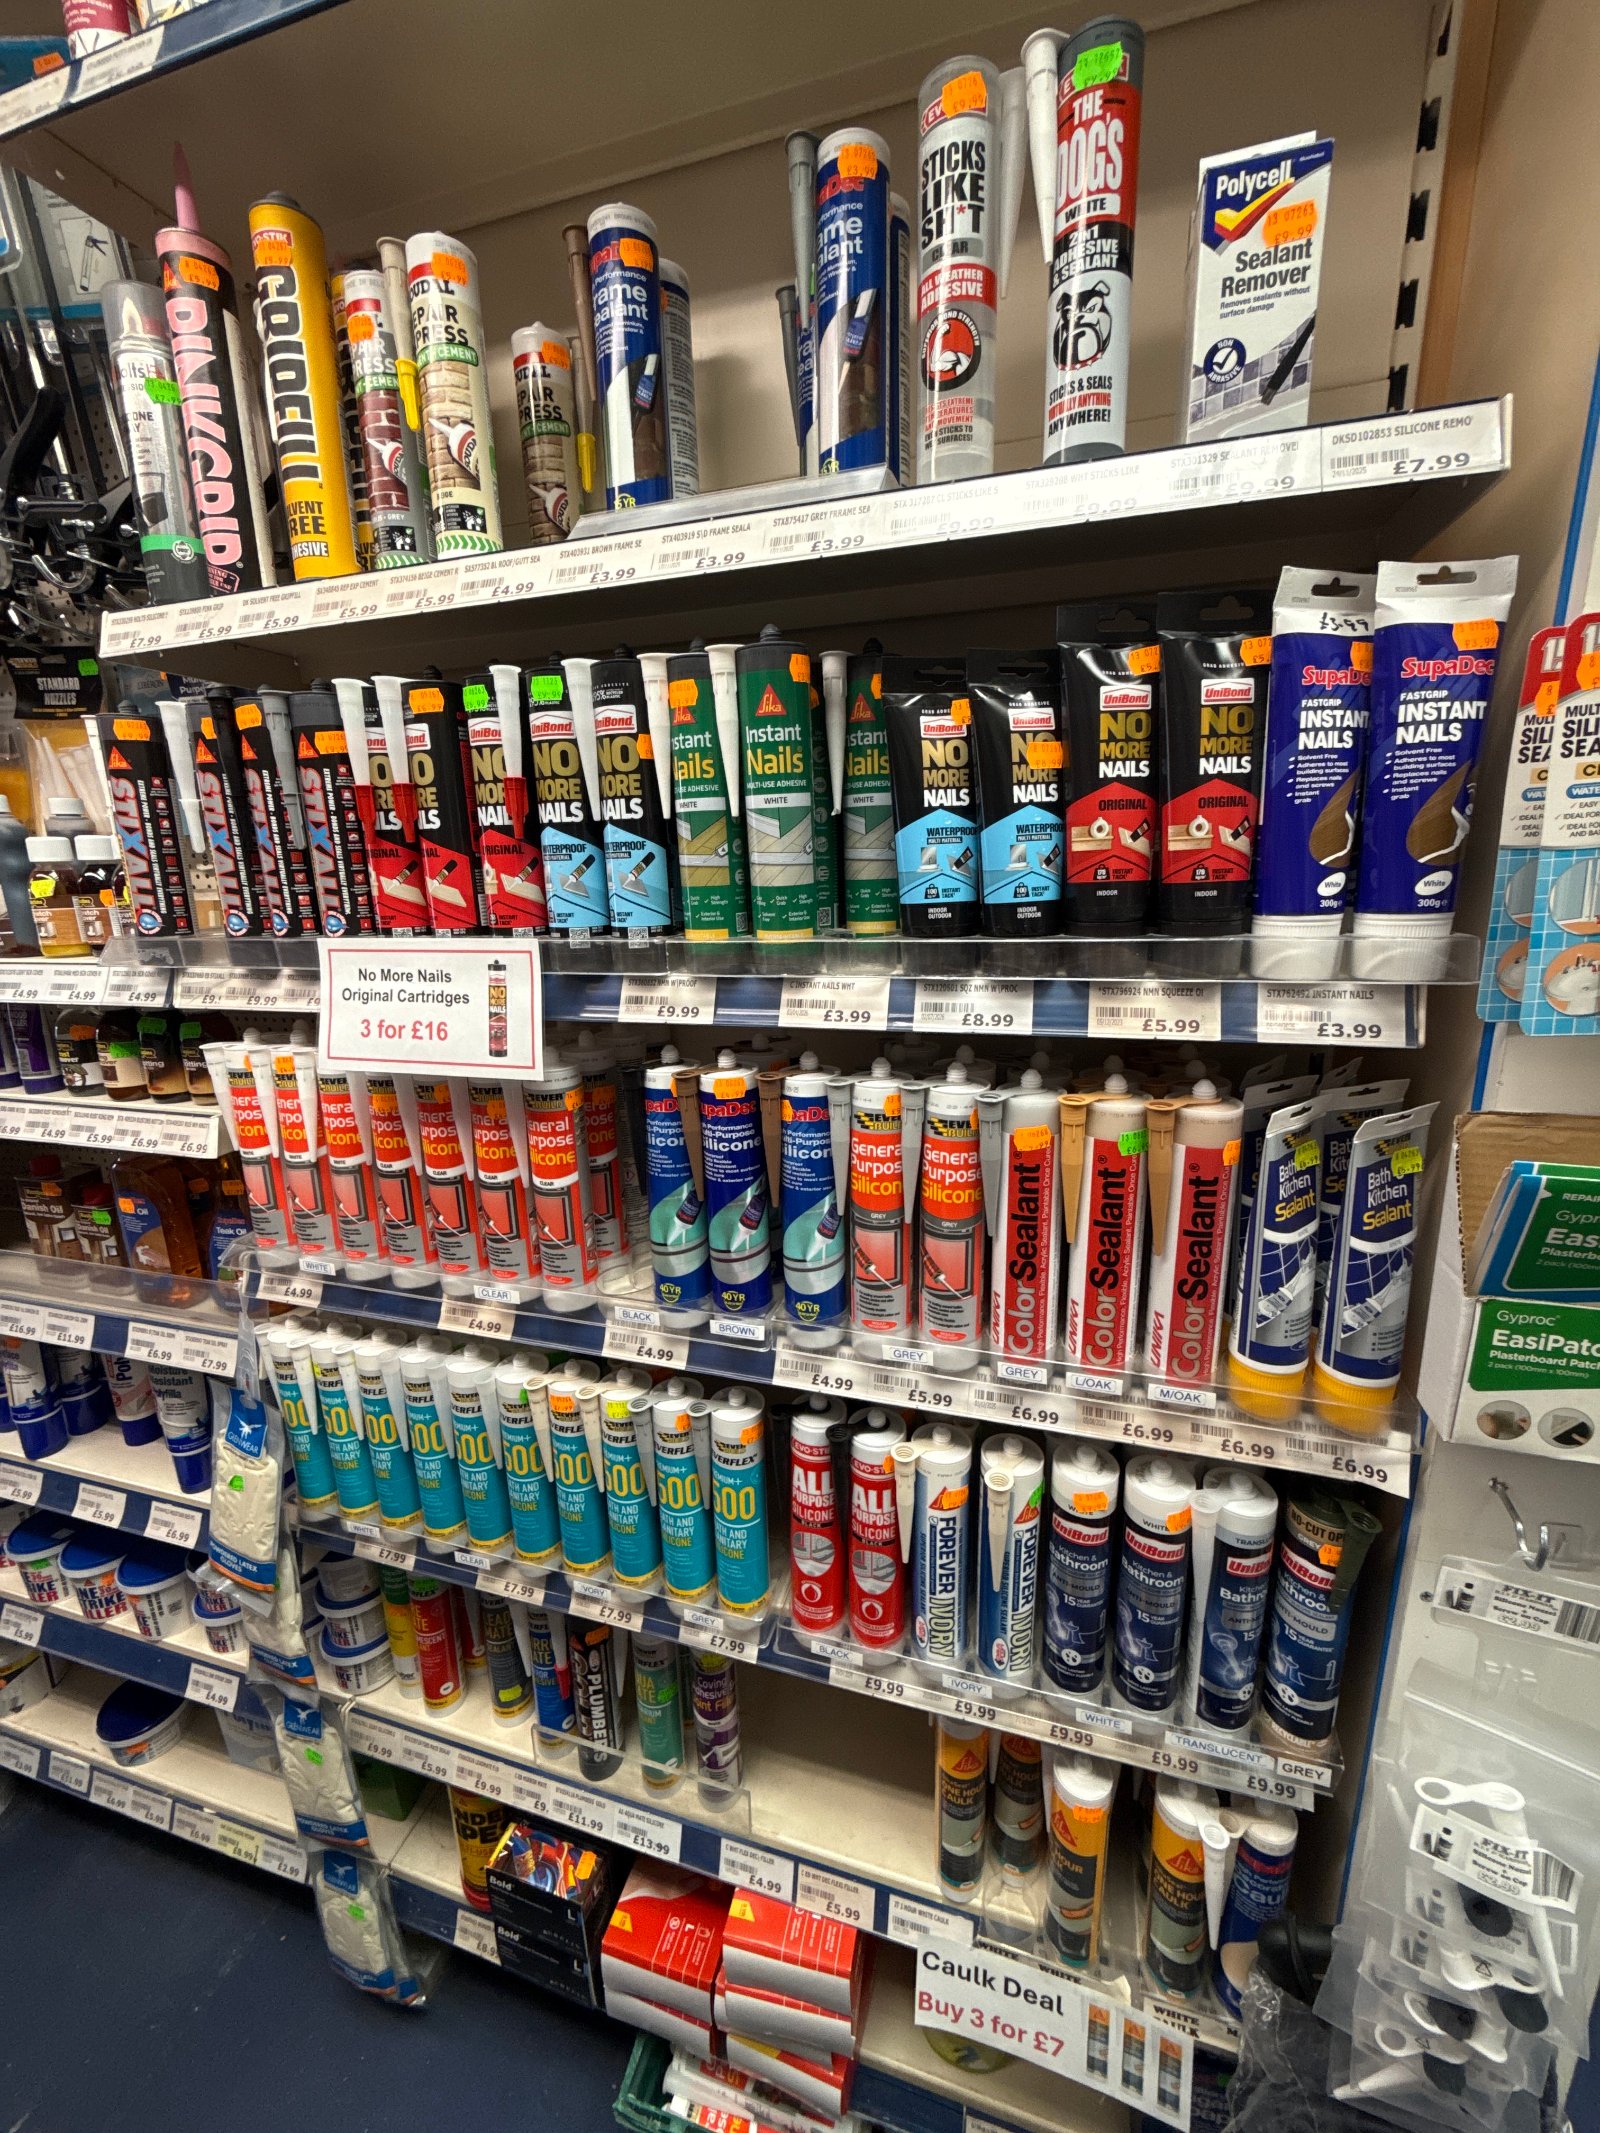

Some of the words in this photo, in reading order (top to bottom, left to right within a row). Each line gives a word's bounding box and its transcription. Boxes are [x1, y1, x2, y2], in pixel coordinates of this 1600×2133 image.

[1073, 89, 1103, 126] THE
[922, 141, 985, 191] STICKS
[1057, 112, 1123, 210] DOG'S
[1216, 159, 1294, 201] Polycell
[922, 172, 985, 209] LIKE
[1055, 239, 1118, 272] ADHESIVE
[1236, 240, 1312, 272] Sealant
[1221, 266, 1310, 297] Remover
[1220, 308, 1244, 319] surface
[1247, 303, 1274, 314] damage
[1332, 428, 1392, 445] DKSD102853
[1395, 421, 1440, 436] SILICONE
[1394, 453, 1470, 475] £7.99
[811, 512, 828, 522] GREY
[810, 535, 865, 552] £3.99
[696, 552, 746, 568] £3.99
[590, 567, 636, 583] £3.99
[492, 582, 534, 597] £4.99
[339, 605, 377, 618] £5.99
[264, 616, 299, 629] £5.99
[199, 626, 231, 638] £5.99
[1401, 656, 1495, 681] SupaDec
[1103, 693, 1149, 704] UniBond
[1204, 687, 1251, 698] UniBond
[1400, 690, 1448, 701] FASTGRIP
[1302, 698, 1342, 707] FASTGRIP
[1201, 706, 1254, 734] NO
[1398, 702, 1486, 723] INSTANT
[746, 724, 801, 743] Instant
[1100, 711, 1151, 740] NO
[1396, 722, 1462, 744] NAILS
[1200, 736, 1252, 756] MORE
[1298, 731, 1353, 749] NAILS
[921, 740, 968, 767] NO
[1100, 741, 1150, 759] MORE
[746, 745, 804, 775] Nails
[1199, 756, 1251, 775] NAILS
[1394, 756, 1427, 764] Adheres
[1099, 760, 1150, 778] NAILS
[923, 769, 969, 787] MORE
[763, 796, 788, 805] WHITE
[923, 788, 970, 807] NAILS
[1013, 784, 1058, 803] NAILS
[1098, 798, 1147, 811] ORIGINAL
[1198, 797, 1248, 809] ORIGINAL
[1423, 879, 1445, 888] White
[359, 968, 377, 982] No
[381, 969, 413, 982] More
[418, 969, 452, 982] Nails
[12, 989, 38, 999] £4.99
[69, 991, 95, 1001] £4.99
[128, 992, 156, 1002] £4.99
[342, 988, 393, 1004] Original
[398, 989, 470, 1006] Cartridges
[1143, 988, 1160, 996] NMN
[1161, 988, 1193, 997] SQUEEZE
[1312, 990, 1348, 1000] INSTANT
[1350, 990, 1374, 1000] NAILS
[247, 996, 278, 1006] £9.99
[657, 1005, 699, 1018] £9.99
[824, 1010, 871, 1023] £3.99
[962, 1012, 1013, 1027] £8.99
[361, 1019, 371, 1038] 3
[378, 1020, 405, 1039] for
[411, 1021, 448, 1041] £16
[1142, 1019, 1200, 1033] £5.99
[1317, 1023, 1382, 1039] £3.99
[86, 1134, 112, 1144] £5.99
[131, 1137, 157, 1148] £6.99
[180, 1142, 207, 1153] £6.99
[1368, 1170, 1391, 1190] Bath
[1368, 1184, 1407, 1208] Kitchen
[1275, 1189, 1315, 1222] Sealant
[1363, 1200, 1411, 1230] Sealant
[306, 1263, 328, 1272] WHITE
[284, 1287, 313, 1299] £4.99
[481, 1289, 508, 1300] CLEAR
[622, 1311, 651, 1322] BLACK
[1497, 1310, 1555, 1326] Gyproc
[9, 1324, 35, 1335] £16.99
[469, 1320, 501, 1333] £4.99
[719, 1324, 755, 1336] BROWN
[57, 1332, 84, 1344] £11.99
[147, 1348, 171, 1361] £6.99
[637, 1346, 674, 1361] £4.99
[893, 1350, 923, 1360] GREY
[1490, 1350, 1566, 1366] Plasterboard
[201, 1357, 226, 1370] £7.99
[1515, 1364, 1547, 1372] (100mm
[1556, 1369, 1589, 1379] 100mm)
[1006, 1367, 1038, 1379] GREY
[812, 1374, 854, 1391] £4.99
[1075, 1377, 1112, 1390] L/OAK
[909, 1389, 952, 1406] £5.99
[1160, 1390, 1201, 1404] M/OAK
[1012, 1406, 1059, 1424] £6.99
[1123, 1424, 1174, 1442] £6.99
[227, 1430, 259, 1454] GLENWEAR
[1221, 1440, 1275, 1459] £6.99
[1333, 1456, 1388, 1482] £6.99
[793, 1467, 833, 1493] ALL
[852, 1485, 895, 1512] ALL
[93, 1510, 114, 1521] £5.99
[166, 1528, 189, 1541] £6.99
[379, 1549, 407, 1563] £7.99
[460, 1553, 485, 1565] CLEAR
[939, 1516, 957, 1595] FOREVER
[1020, 1527, 1038, 1609] FOREVER
[503, 1581, 534, 1597] £7.99
[600, 1606, 632, 1623] £7.99
[691, 1613, 716, 1626] GREY
[819, 1645, 849, 1659] BLACK
[864, 1677, 905, 1696] £9.99
[951, 1679, 982, 1693] IVORY
[205, 1693, 228, 1705] £4.99
[955, 1700, 996, 1721] £9.99
[1086, 1713, 1120, 1729] WHITE
[1050, 1724, 1094, 1747] £9.99
[1176, 1735, 1262, 1761] TRANSLUCENT
[1152, 1751, 1199, 1773] £9.99
[1281, 1761, 1324, 1780] GREY
[1247, 1775, 1297, 1798] £9.99
[922, 1951, 996, 1991] Caulk
[1003, 1977, 1064, 2016] Deal
[918, 1991, 964, 2024] Buy
[970, 2008, 984, 2029] 3
[990, 2016, 1027, 2043] for
[1033, 2030, 1064, 2058] £7
